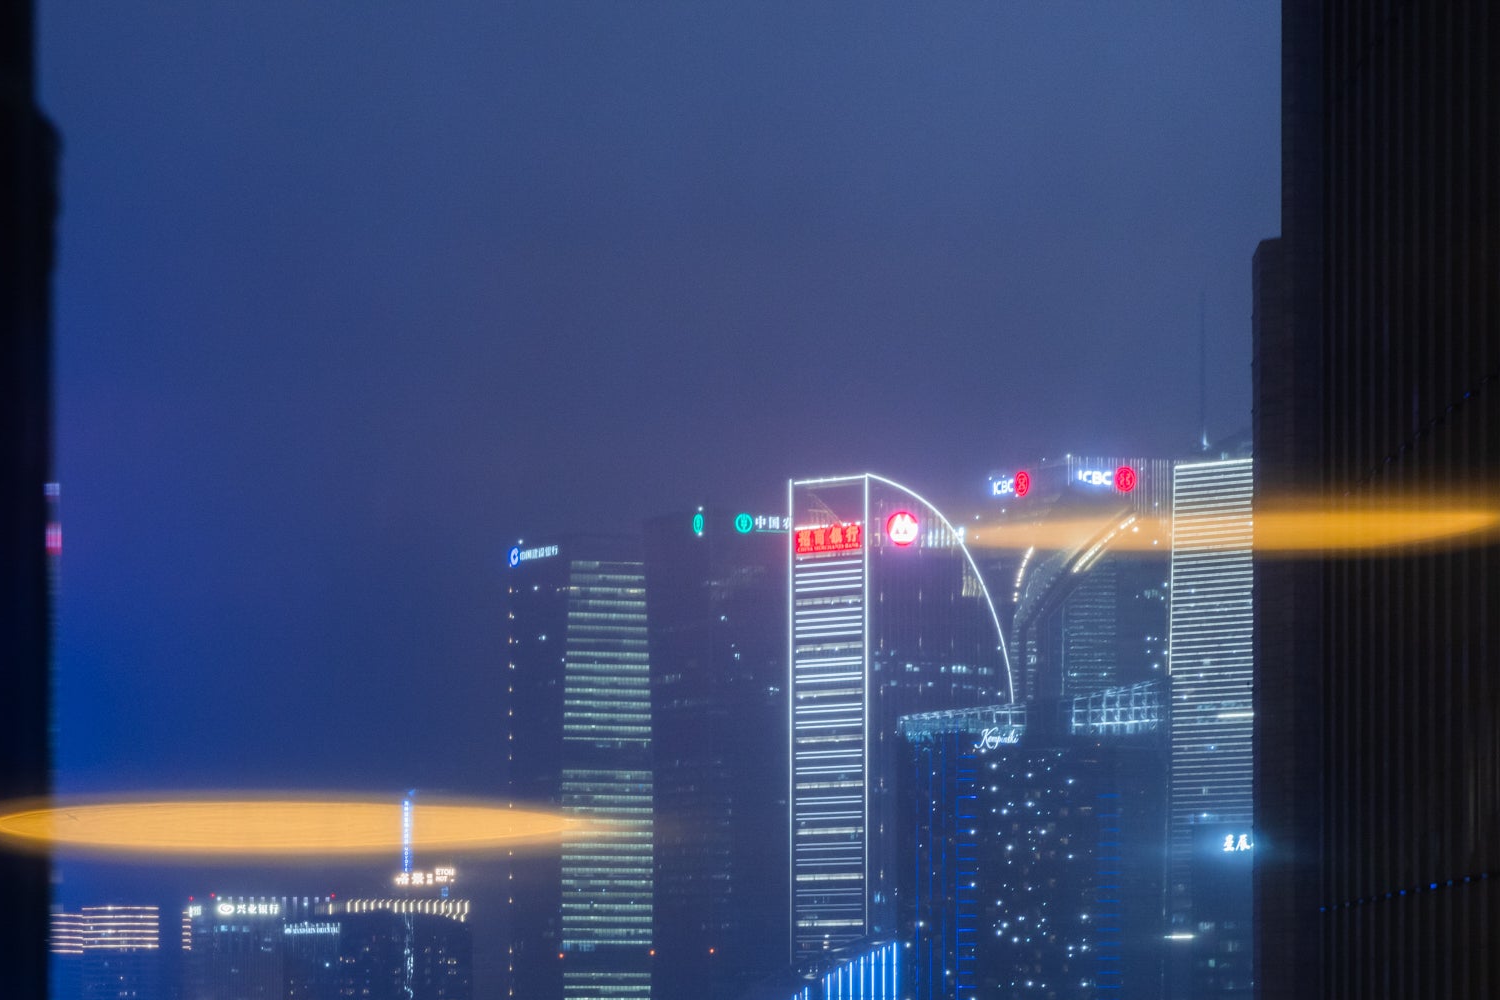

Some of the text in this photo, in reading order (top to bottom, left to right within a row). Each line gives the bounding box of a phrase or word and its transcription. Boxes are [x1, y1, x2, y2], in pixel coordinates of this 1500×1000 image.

[1078, 470, 1112, 485] ICBC
[993, 479, 1014, 495] ICBC
[798, 525, 859, 547] 招商银行
[236, 902, 279, 915] 兴业银行
